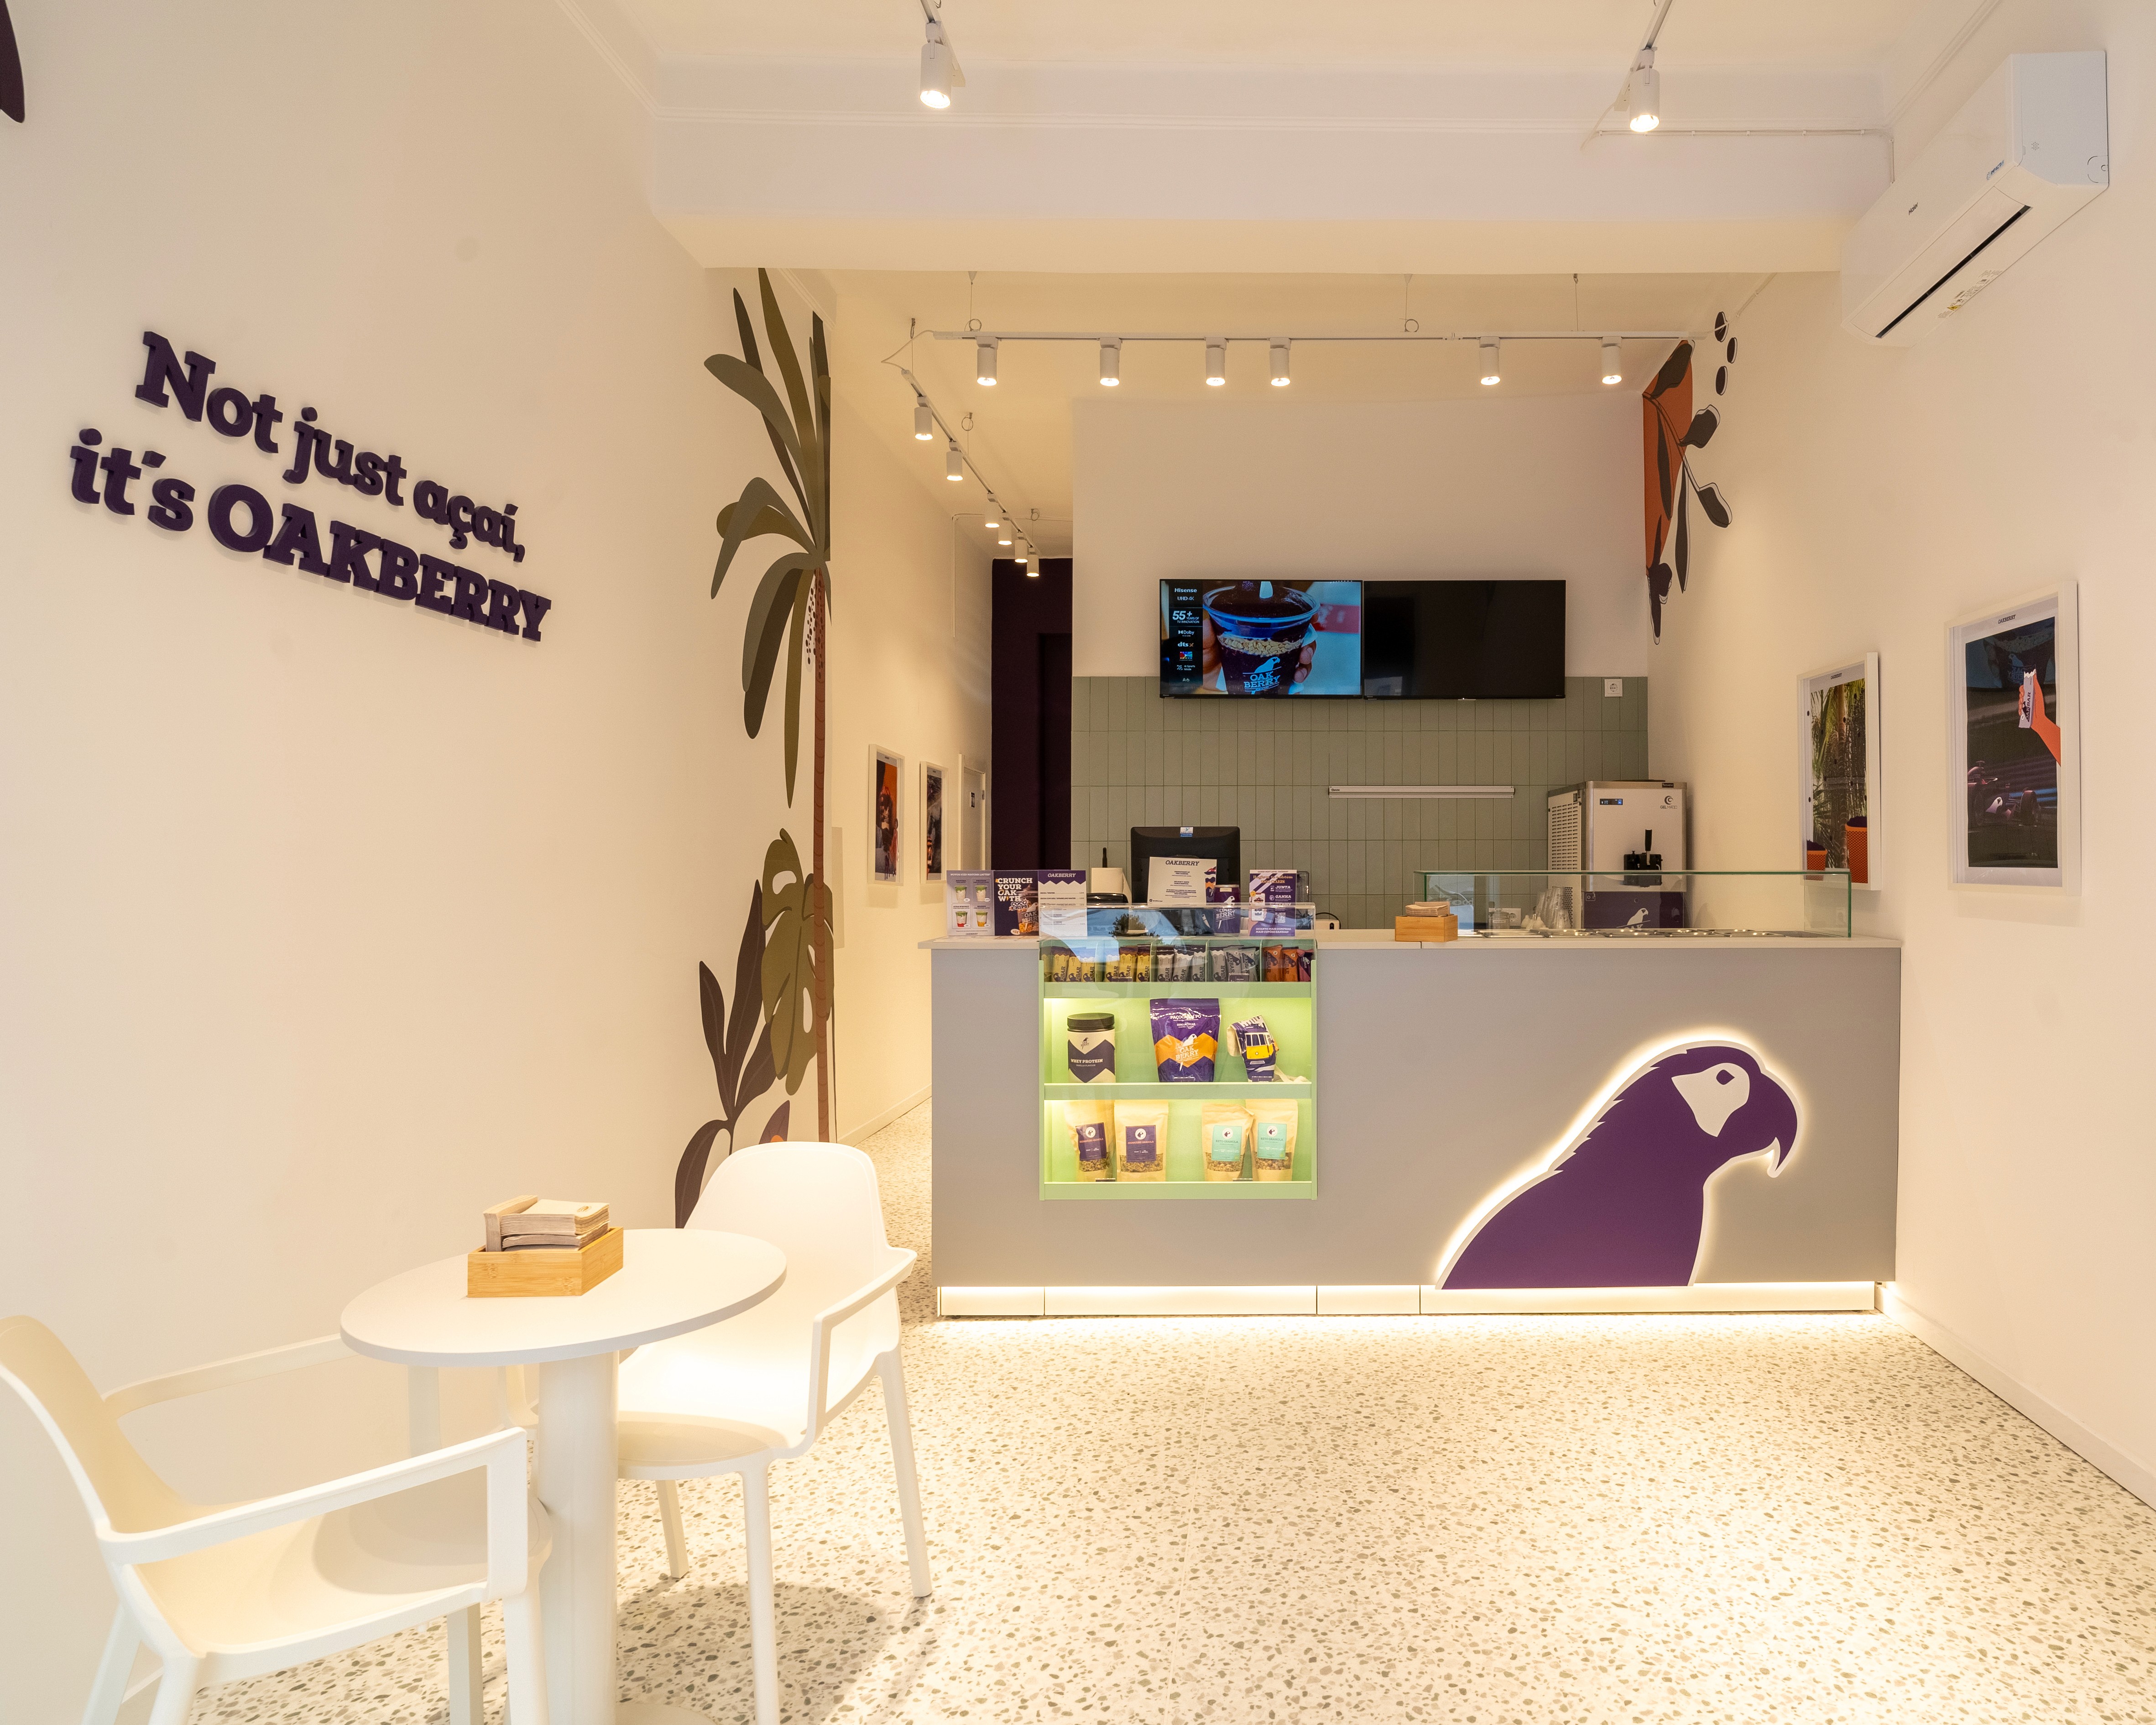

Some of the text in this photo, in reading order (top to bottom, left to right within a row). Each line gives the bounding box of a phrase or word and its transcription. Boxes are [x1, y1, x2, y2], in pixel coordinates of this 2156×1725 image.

[1909, 202, 1918, 215] Haier
[135, 331, 525, 563] Not just açaí,
[207, 484, 552, 642] OAKBERRY
[1998, 614, 2016, 624] OAKBERRY
[1244, 675, 1280, 688] BERRY
[1250, 671, 1274, 681] OAK
[1216, 910, 1236, 919] BERRY
[1175, 1049, 1199, 1060] BERRY
[1180, 1045, 1194, 1053] OAK
